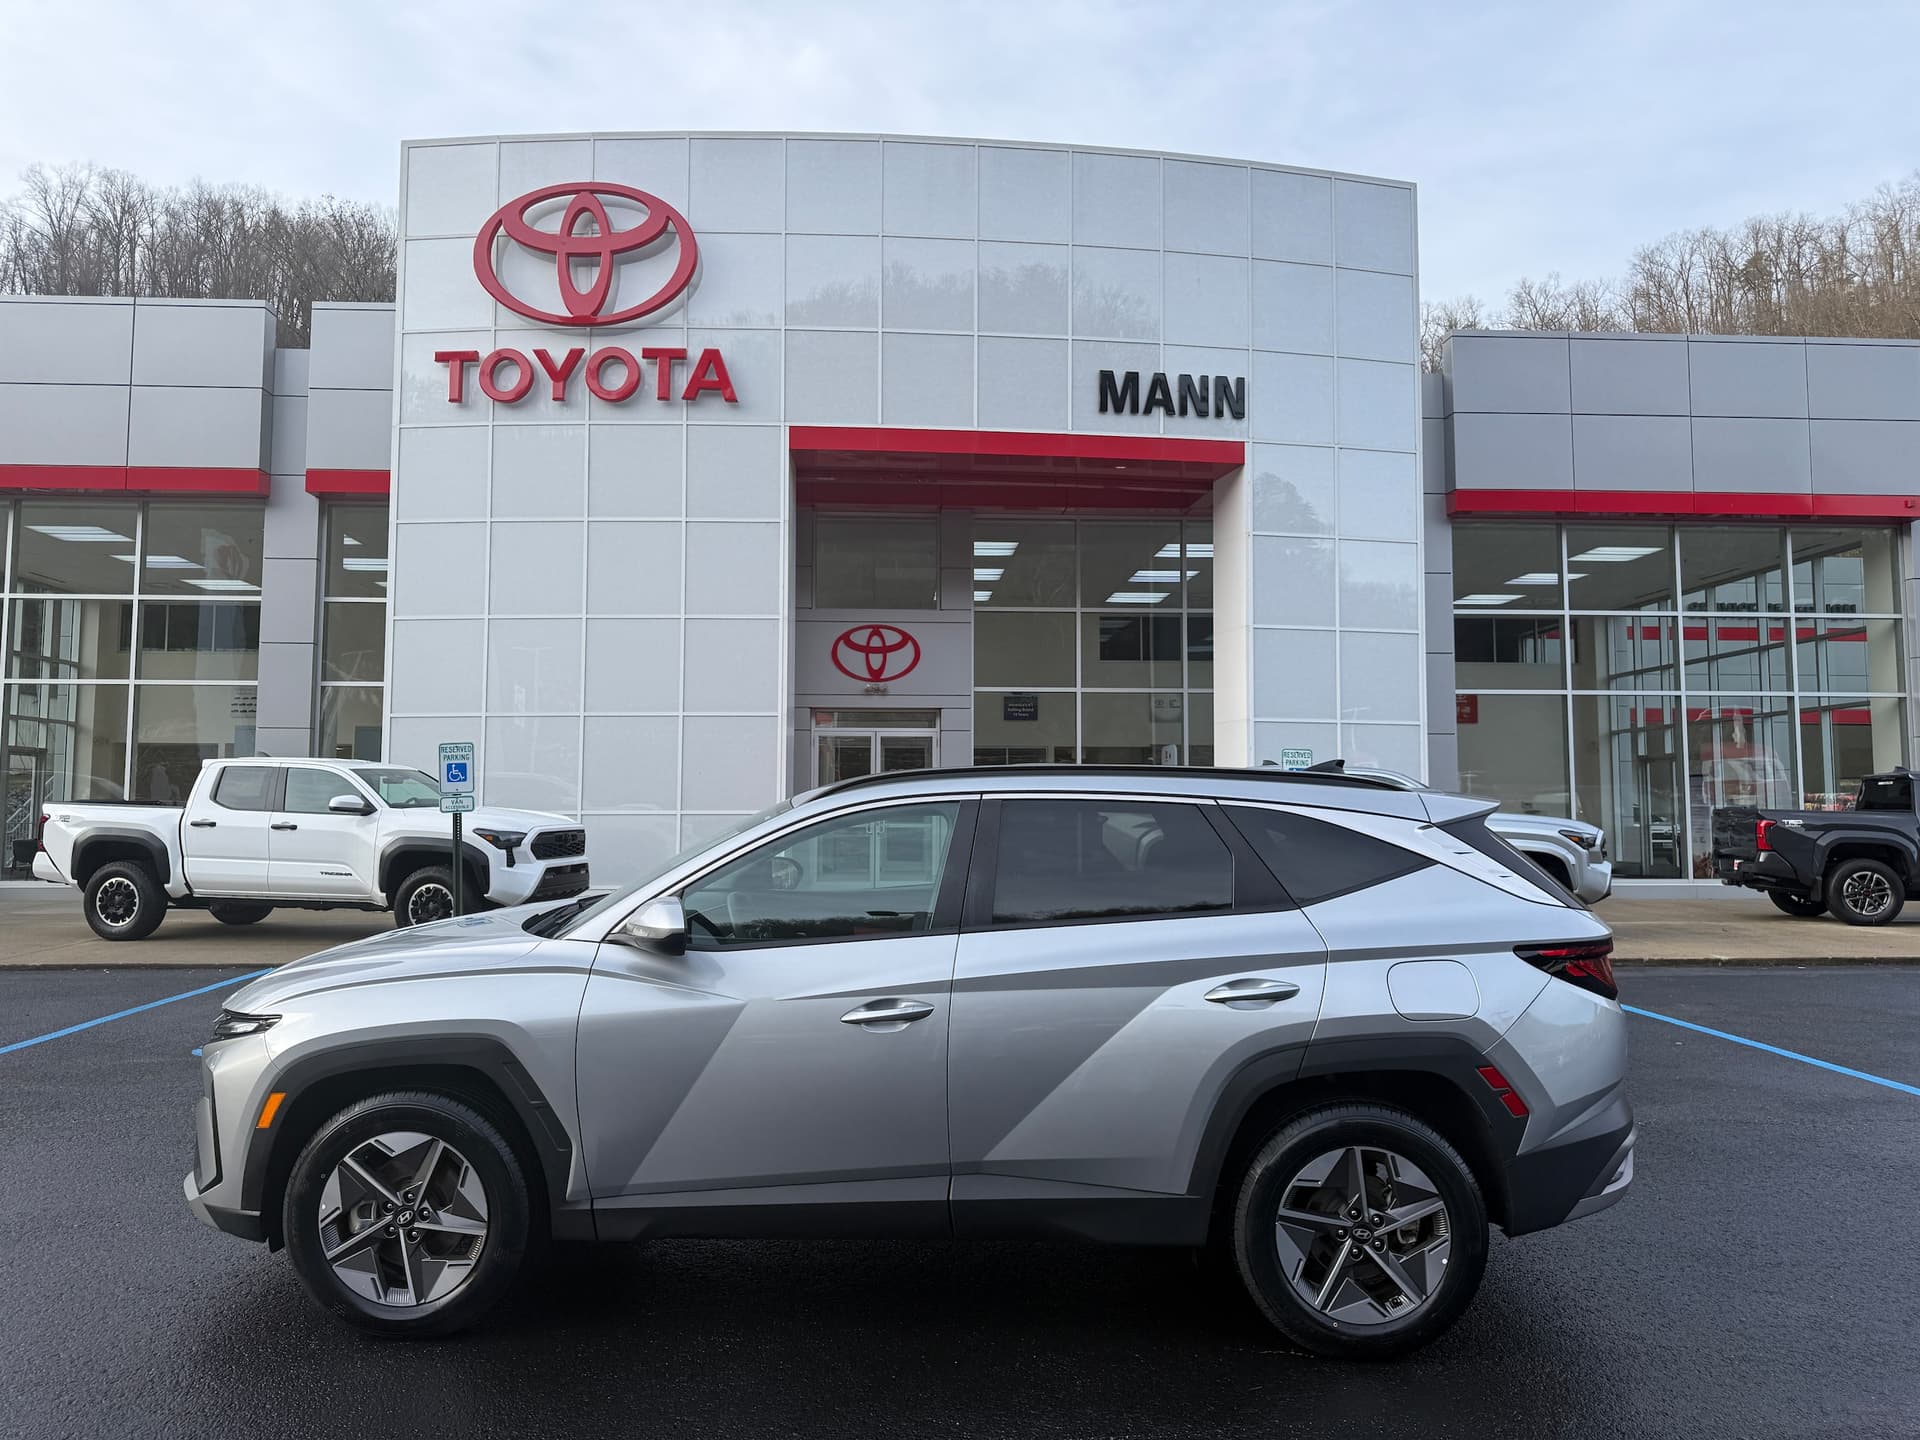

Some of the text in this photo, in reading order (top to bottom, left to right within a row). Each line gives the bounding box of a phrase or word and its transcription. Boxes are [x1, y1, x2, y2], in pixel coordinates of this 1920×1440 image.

[434, 347, 739, 403] TOYOTA
[1099, 370, 1246, 419] MANN
[440, 745, 472, 754] RESERVED
[1283, 751, 1312, 759] RESERVED
[1285, 759, 1310, 767] PARKING
